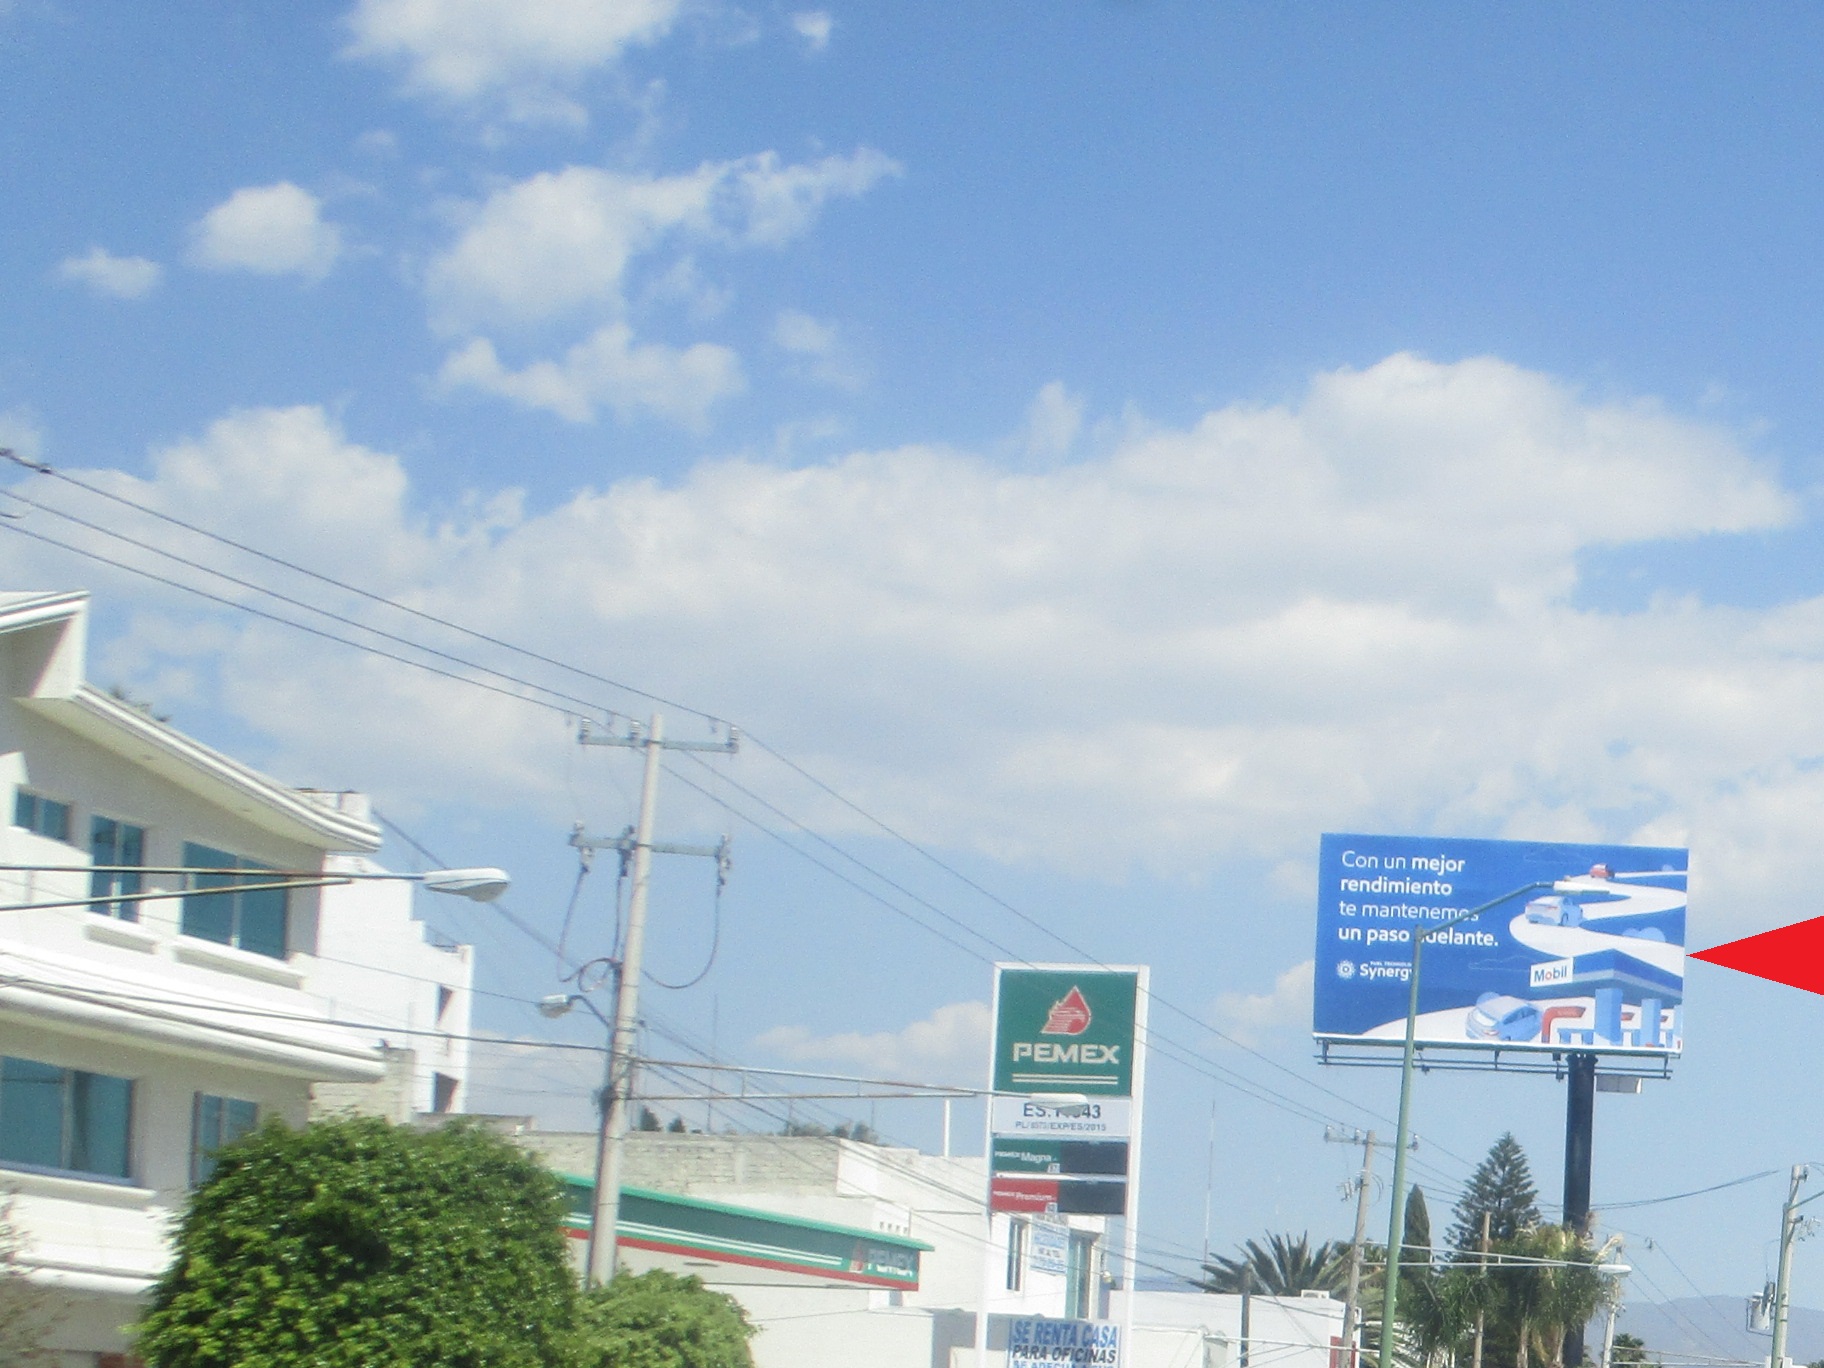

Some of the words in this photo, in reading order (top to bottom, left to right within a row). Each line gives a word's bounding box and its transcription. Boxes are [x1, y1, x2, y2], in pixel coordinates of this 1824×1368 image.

[1342, 850, 1378, 869] Con
[1384, 856, 1406, 870] un
[1411, 854, 1466, 876] mejor
[1340, 876, 1453, 896] rendimiento
[1339, 900, 1357, 916] te
[1338, 927, 1362, 941] un
[1366, 928, 1410, 946] paso
[1414, 926, 1499, 947] delante.
[1534, 965, 1568, 982] Mobil
[1013, 1042, 1120, 1064] PEMEX
[1020, 1151, 1052, 1164] Magna
[1014, 1320, 1032, 1344] SE
[1034, 1322, 1077, 1346] RENTA
[1082, 1324, 1118, 1348] CASA
[1012, 1344, 1047, 1360] PARA
[1052, 1347, 1117, 1364] OFICINAS
